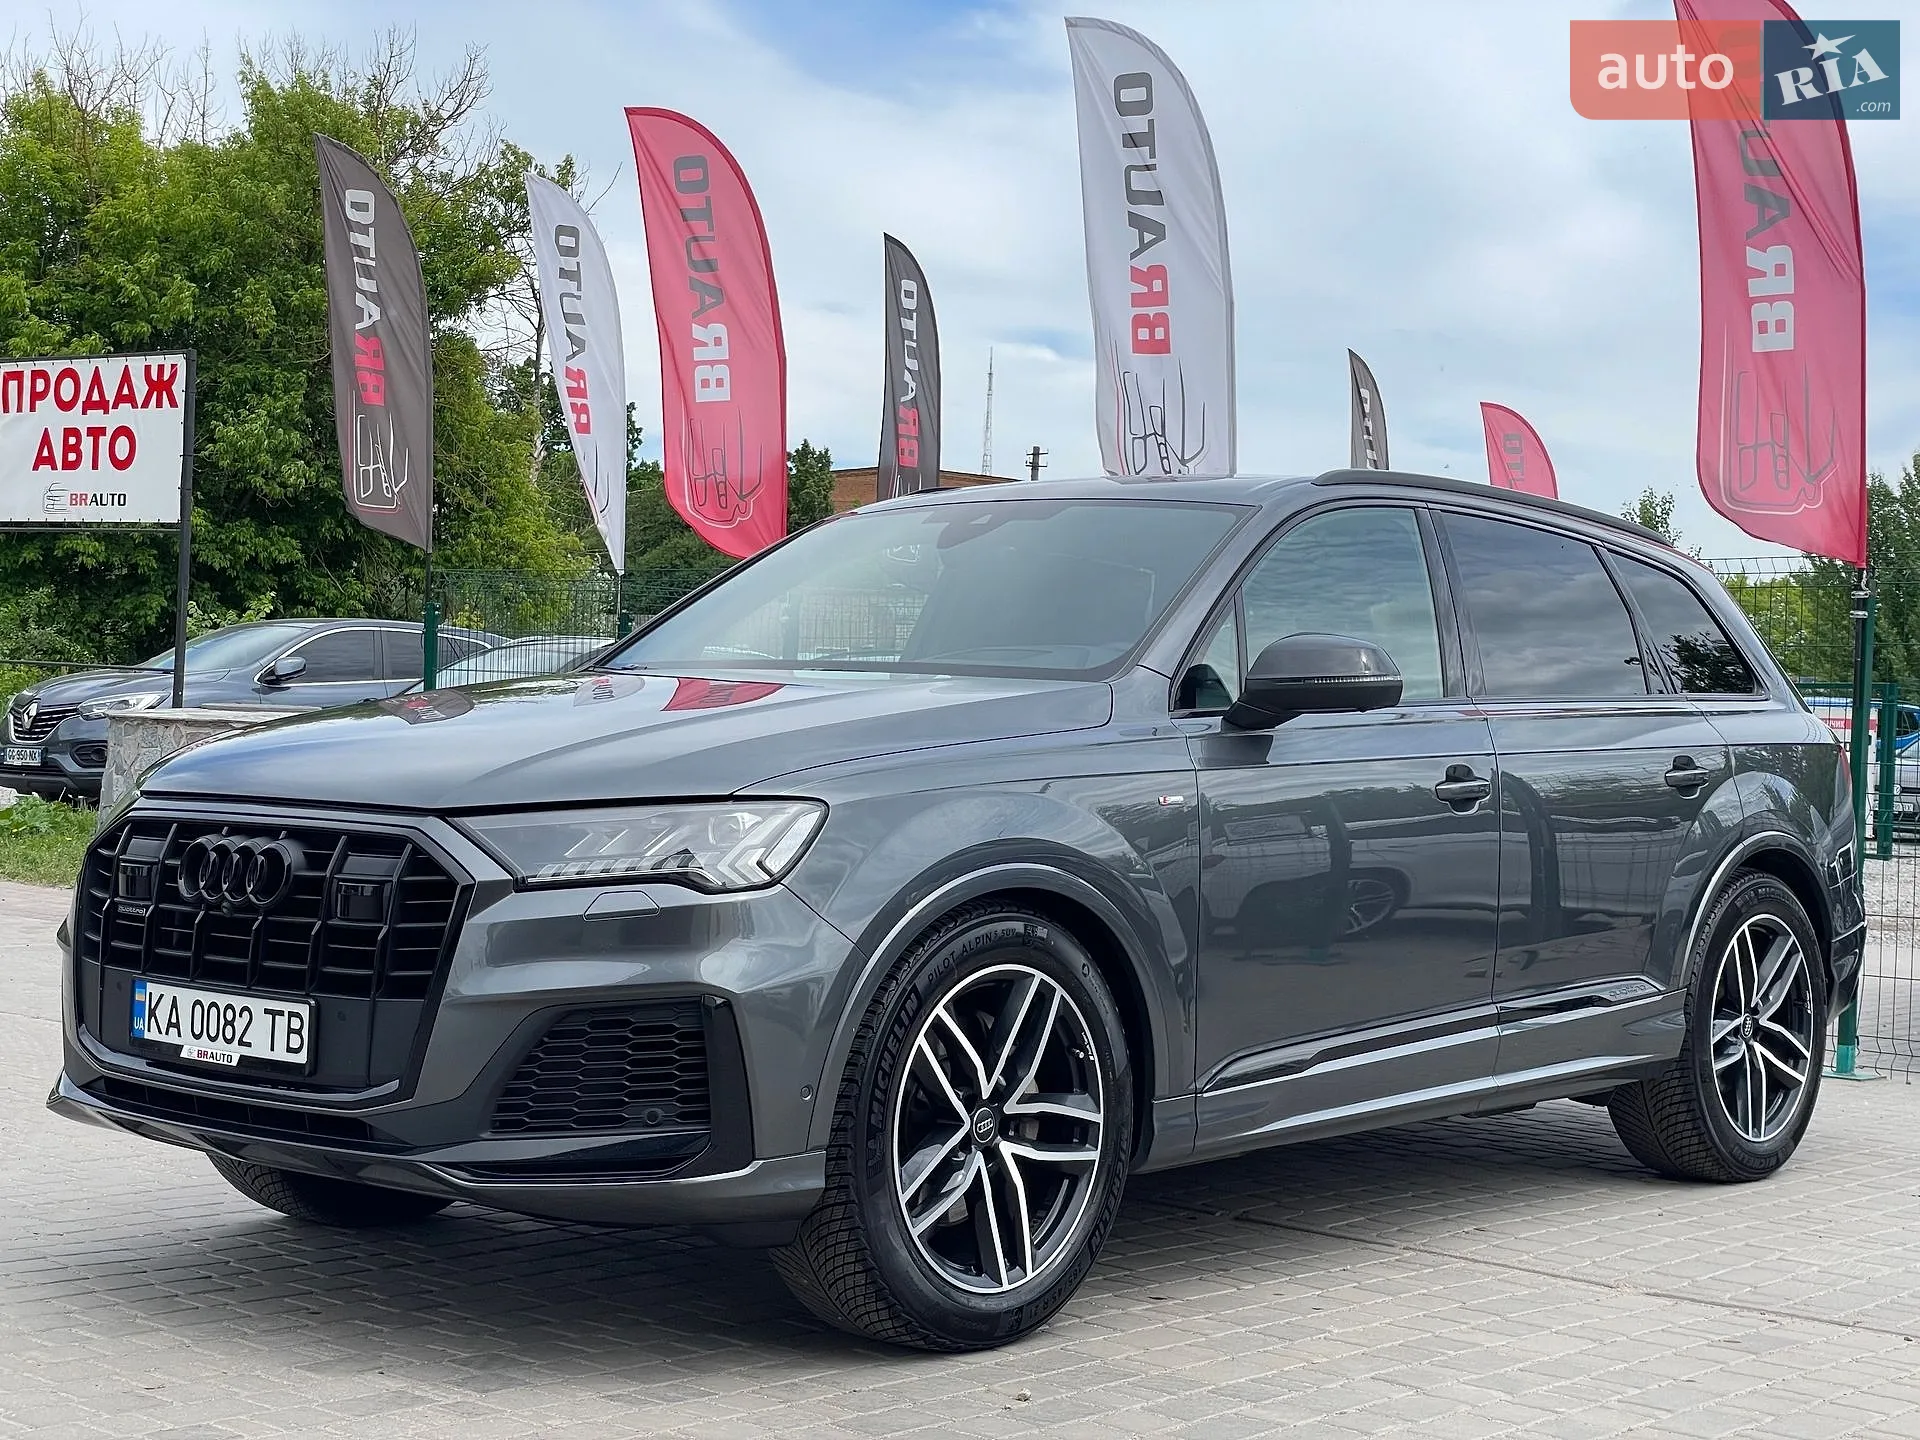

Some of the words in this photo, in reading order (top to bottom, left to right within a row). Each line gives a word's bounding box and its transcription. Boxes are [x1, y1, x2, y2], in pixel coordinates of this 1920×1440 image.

[2, 363, 179, 416] ПРОДАЖ
[31, 424, 137, 472] АВТО
[69, 492, 127, 507] BRAUTO
[927, 950, 957, 985] PILOT
[960, 933, 993, 957] ALPIN
[133, 1016, 145, 1031] UA
[147, 991, 183, 1039] KA
[190, 998, 254, 1049] 0082
[263, 1007, 305, 1055] TB
[196, 1048, 233, 1065] BRAUTO
[870, 991, 919, 1130] MICHELIN
